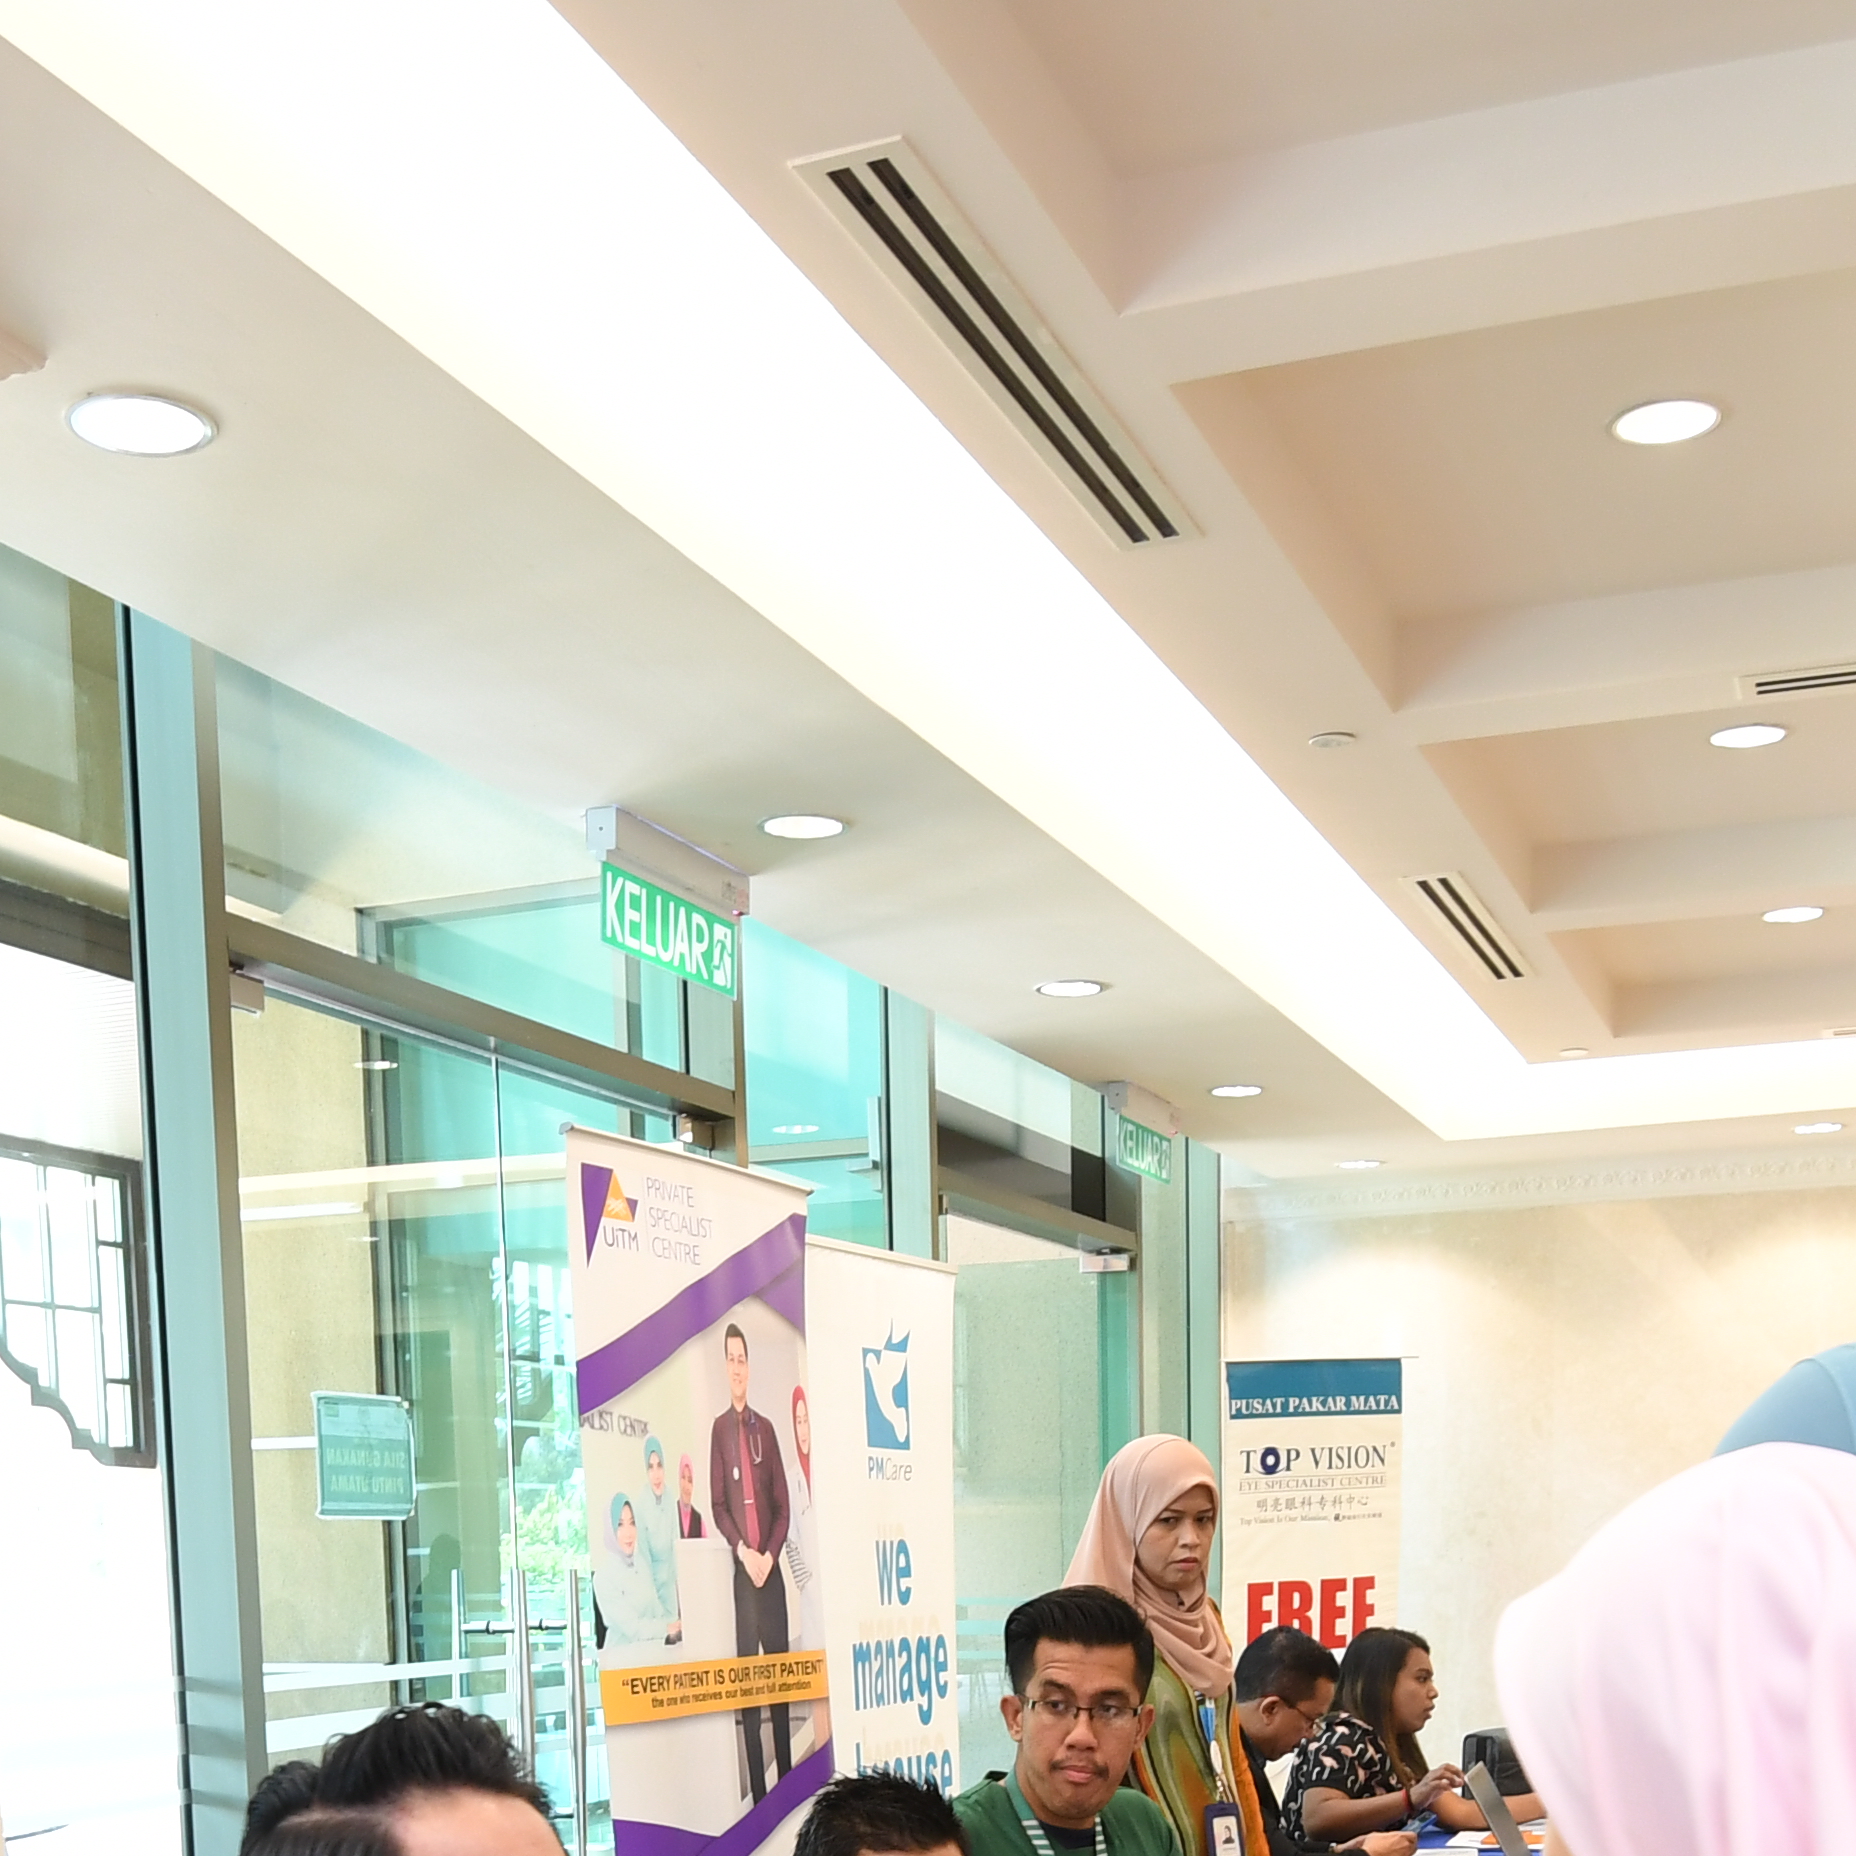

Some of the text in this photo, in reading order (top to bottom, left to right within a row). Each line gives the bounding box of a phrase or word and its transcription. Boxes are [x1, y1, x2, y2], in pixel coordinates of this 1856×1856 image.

[606, 871, 709, 980] KELUAR
[1120, 1119, 1160, 1177] KELUAR
[646, 1176, 694, 1208] PRIVATE
[602, 1225, 639, 1252] UiTM
[649, 1208, 712, 1240] SPECIALIST
[652, 1237, 700, 1265] CENTRE
[1231, 1395, 1399, 1416] PUSAT PAKAR MATA
[868, 1456, 913, 1481] PMCare
[1240, 1445, 1387, 1475] TOP VISION
[1239, 1475, 1386, 1492] EYE SPECIALIST CENTRE
[875, 1538, 913, 1606] we
[1247, 1575, 1376, 1649] FREE
[673, 1671, 710, 1690] PATIENT
[714, 1669, 725, 1685] IS
[728, 1666, 751, 1684] OUR
[753, 1664, 777, 1680] FIRST
[852, 1633, 948, 1725] manage
[691, 1689, 723, 1705] receives
[725, 1688, 739, 1699] our
[739, 1684, 754, 1697] best
[778, 1680, 811, 1693] attention
